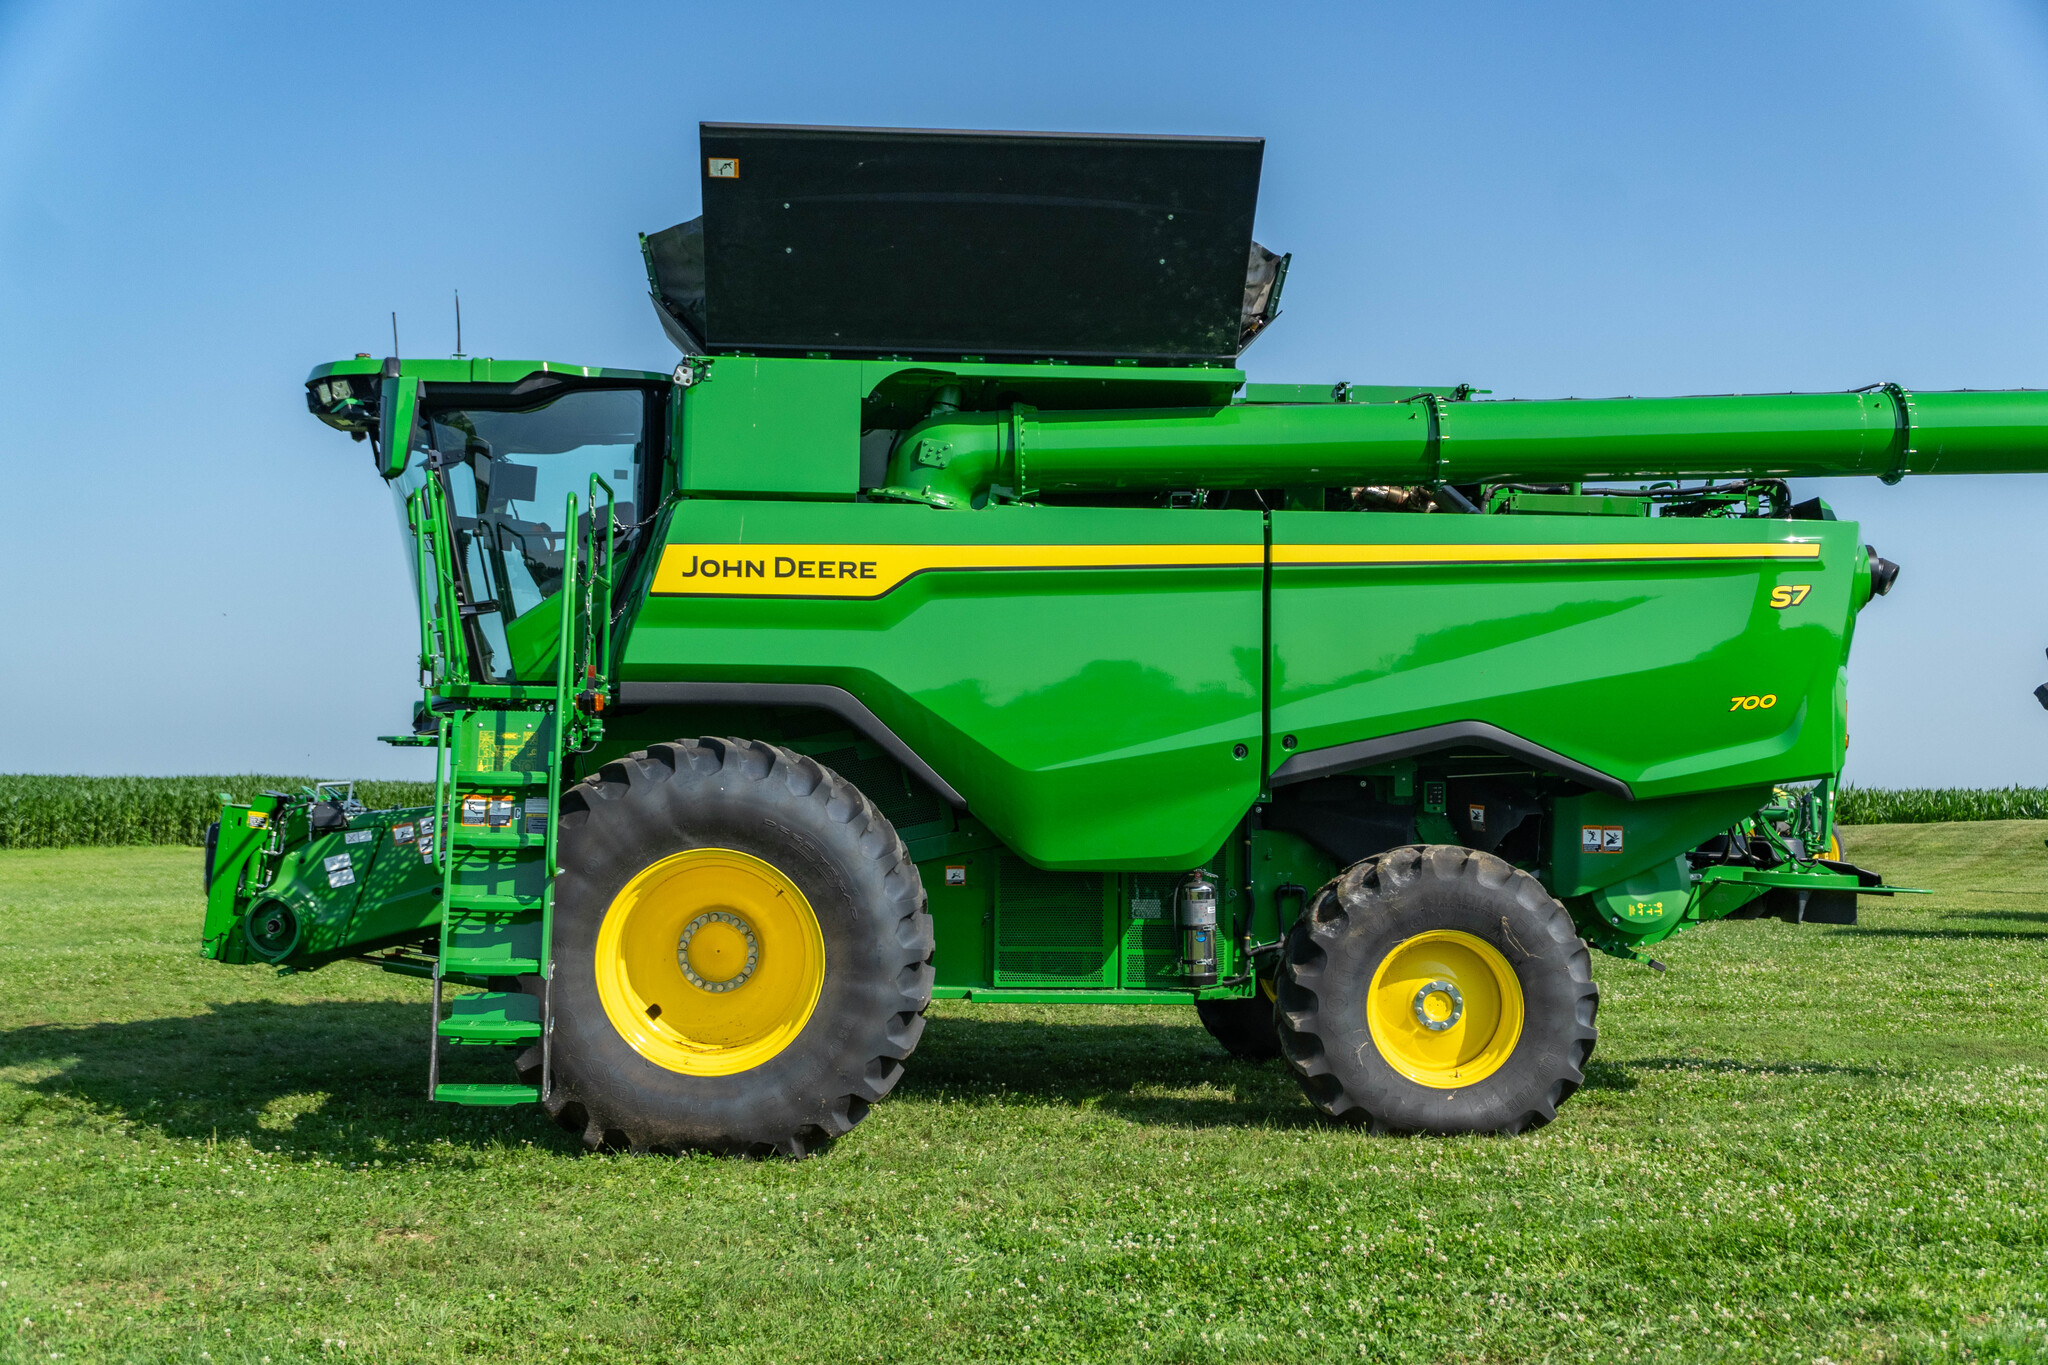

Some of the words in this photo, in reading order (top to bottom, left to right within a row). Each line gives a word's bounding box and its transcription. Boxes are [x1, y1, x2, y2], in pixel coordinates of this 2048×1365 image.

[682, 555, 765, 578] JOHN
[774, 556, 877, 579] DEERE
[1769, 584, 1812, 610] S7
[1728, 693, 1778, 713] 700
